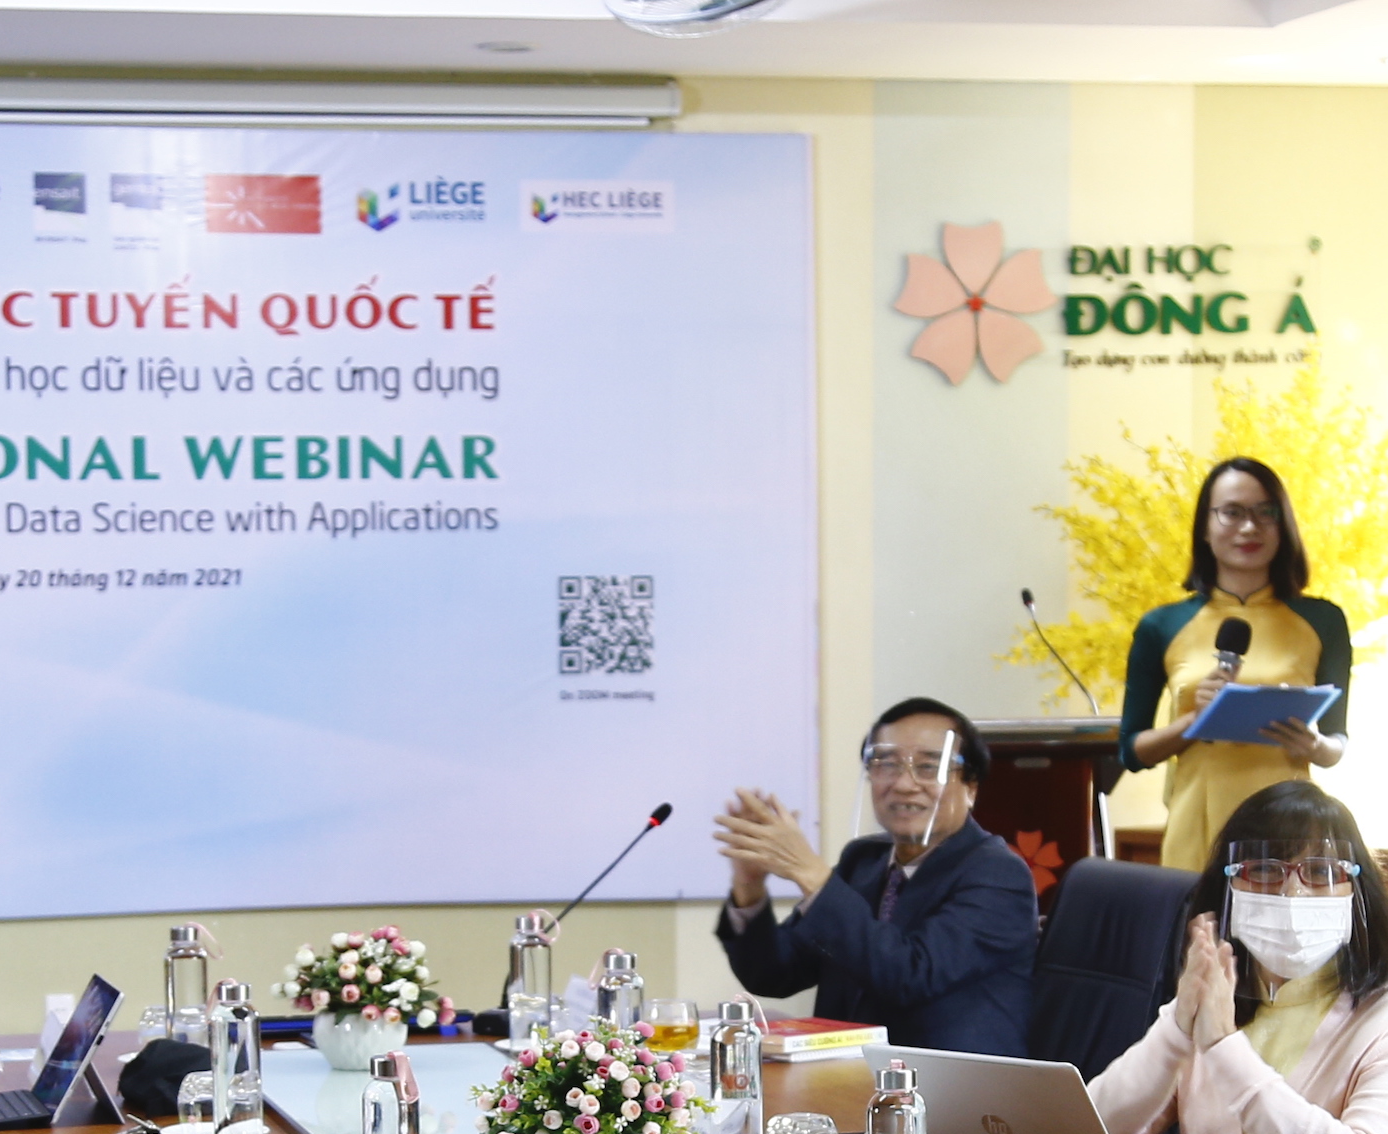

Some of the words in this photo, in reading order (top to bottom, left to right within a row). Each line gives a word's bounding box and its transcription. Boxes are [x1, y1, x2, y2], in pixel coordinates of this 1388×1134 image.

[409, 176, 486, 205] LIÈGE
[563, 190, 601, 208] HEC
[607, 188, 663, 208] LIÈGE
[1068, 245, 1131, 281] ĐẠI
[1148, 244, 1233, 281] HỌC
[51, 276, 239, 330] TUYẾN
[260, 277, 419, 337] QUỐC
[434, 277, 497, 332] TẾ
[1063, 282, 1250, 337] ĐÔNG
[5, 357, 70, 399] học
[81, 356, 129, 393] dữ
[138, 357, 202, 400] liệu
[213, 357, 256, 393] và
[267, 357, 325, 394] các
[336, 357, 403, 401] ứng
[413, 358, 501, 402] dụng
[184, 434, 501, 481] WEBINAR
[5, 503, 83, 535] Data
[92, 502, 216, 534] Science
[226, 502, 298, 533] with
[307, 501, 502, 541] Applications
[15, 570, 42, 588] 20
[48, 569, 109, 591] tháng
[117, 569, 138, 588] 12
[142, 569, 190, 588] năm
[194, 568, 243, 588] 2021
